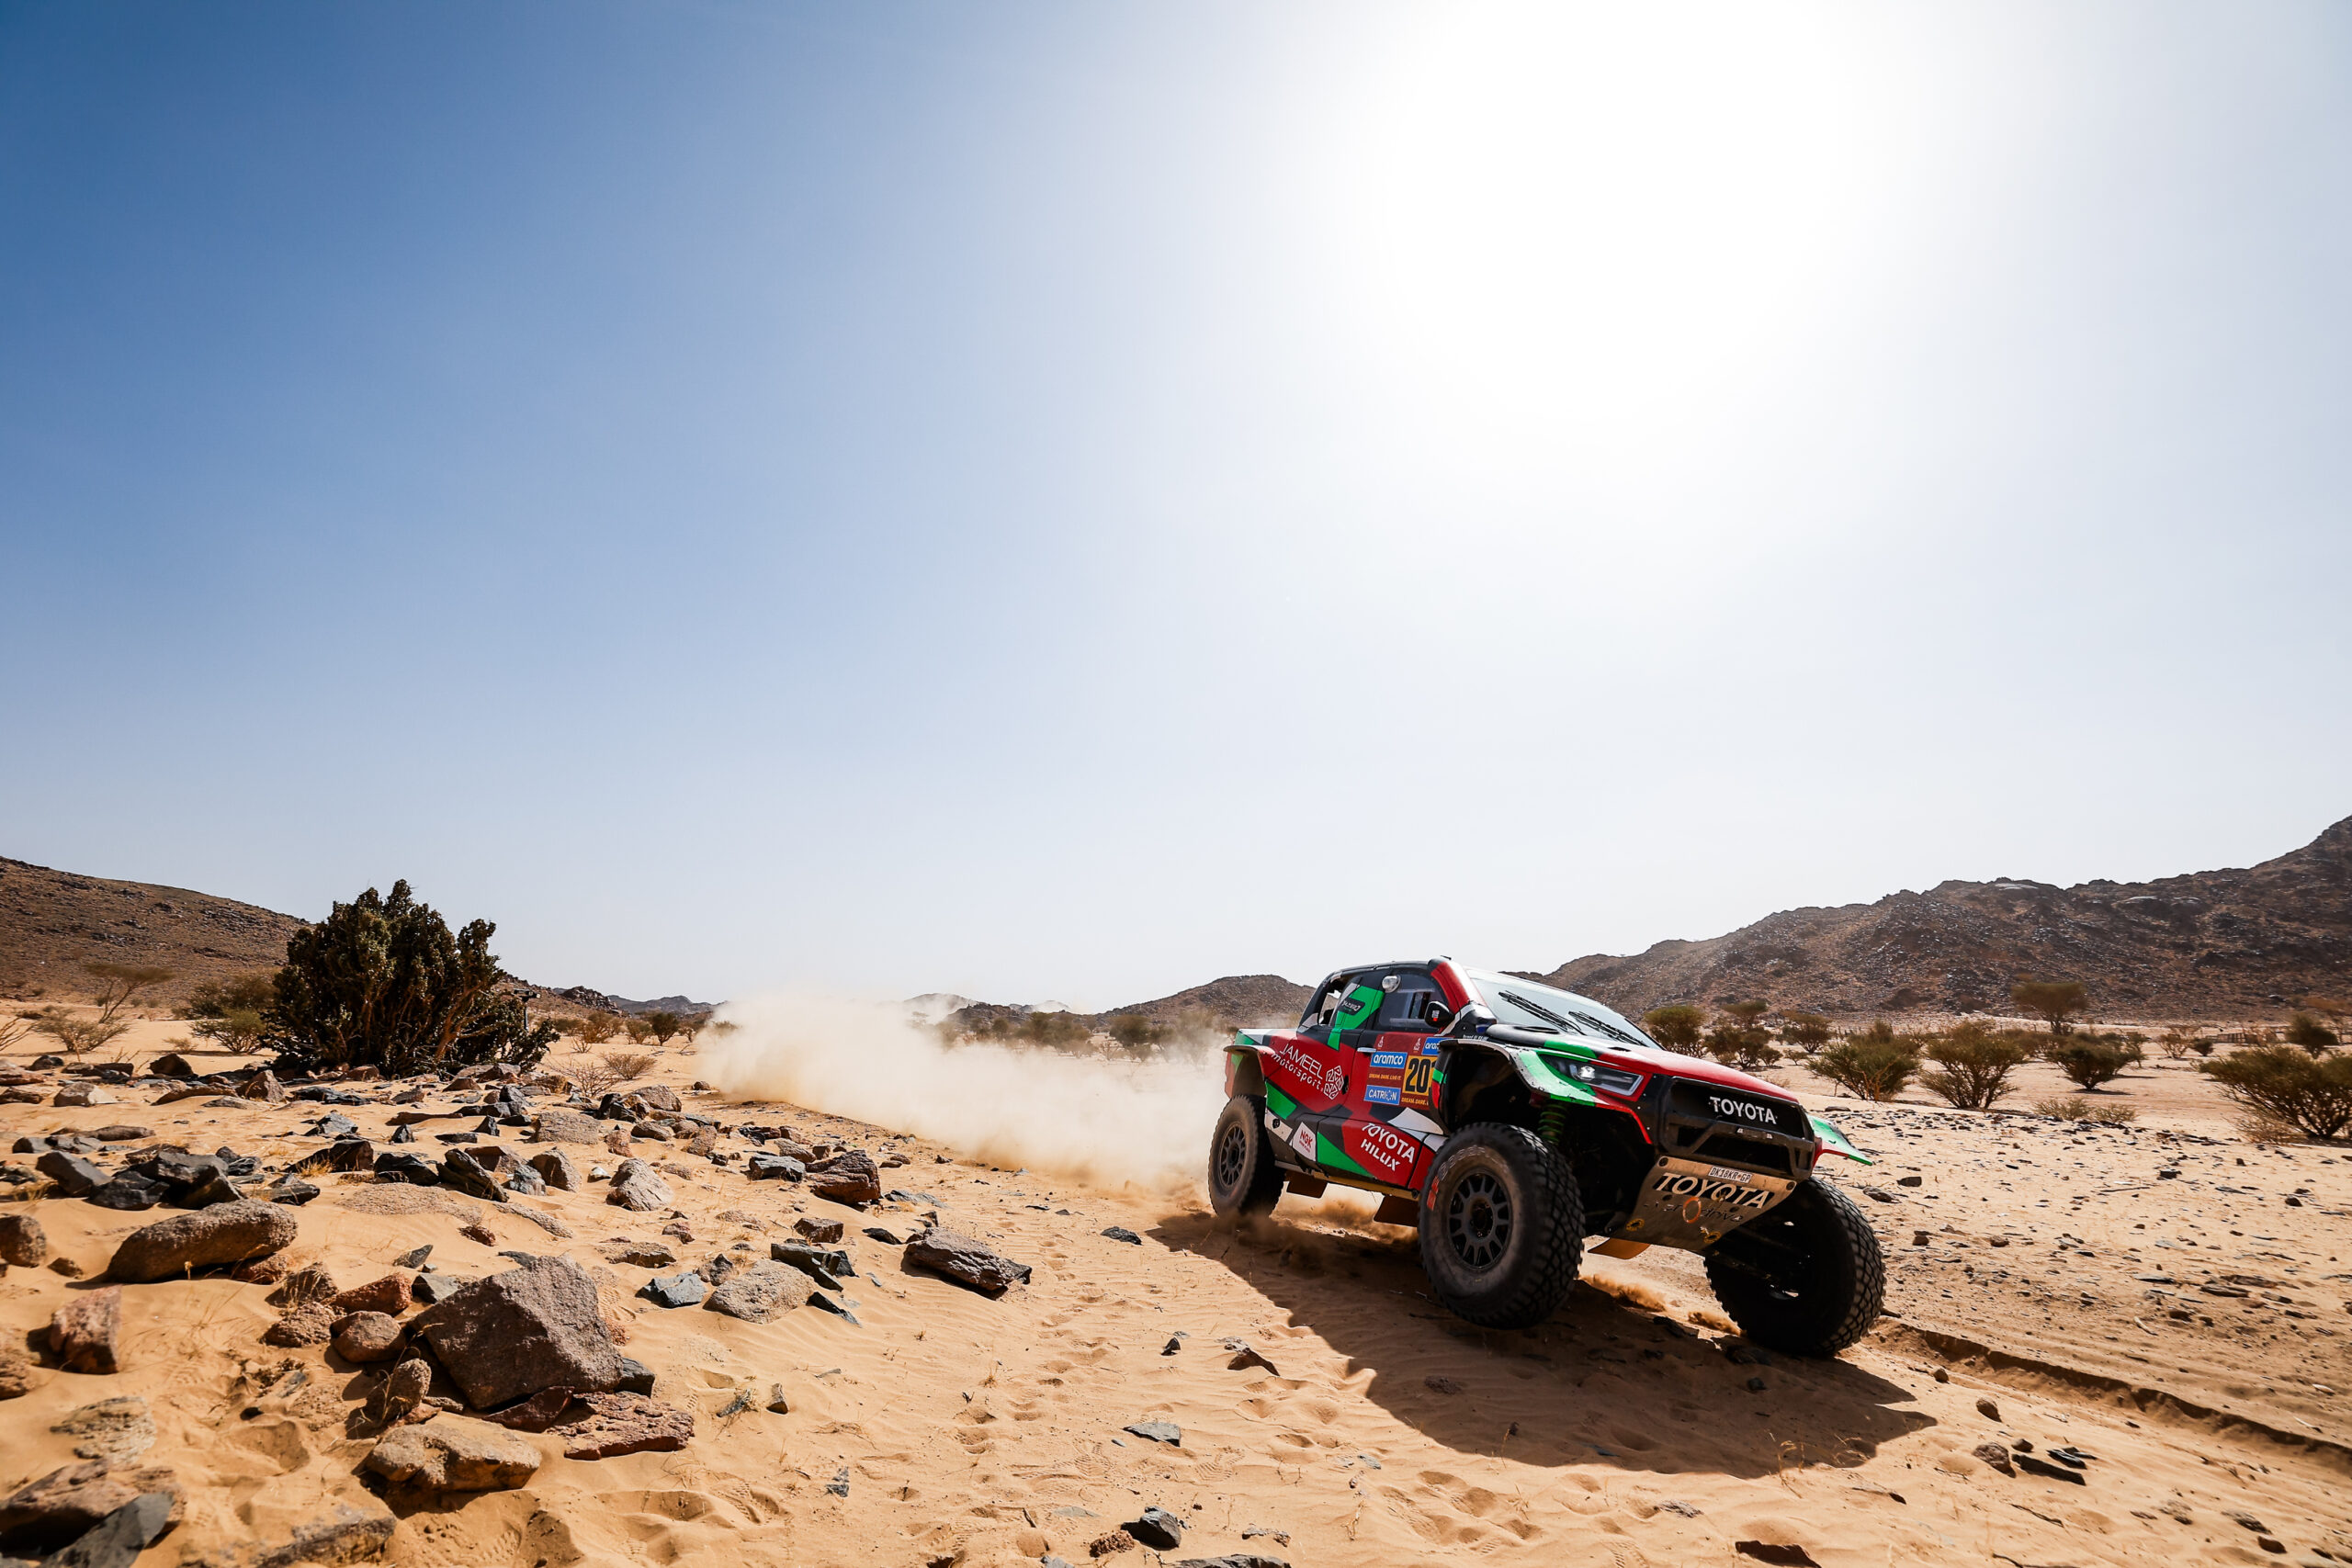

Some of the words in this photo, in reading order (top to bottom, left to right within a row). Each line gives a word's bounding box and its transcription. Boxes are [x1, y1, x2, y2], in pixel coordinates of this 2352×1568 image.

[1279, 1043, 1323, 1079] JAMEEL
[1373, 1055, 1404, 1066] aramco
[1368, 1089, 1397, 1101] CATRION
[1710, 1096, 1777, 1124] TOYOTA
[1299, 1130, 1313, 1148] NGK
[1362, 1122, 1415, 1164] TOYOTA
[1361, 1138, 1400, 1171] HILUX
[1655, 1172, 1770, 1209] TOYOTA
